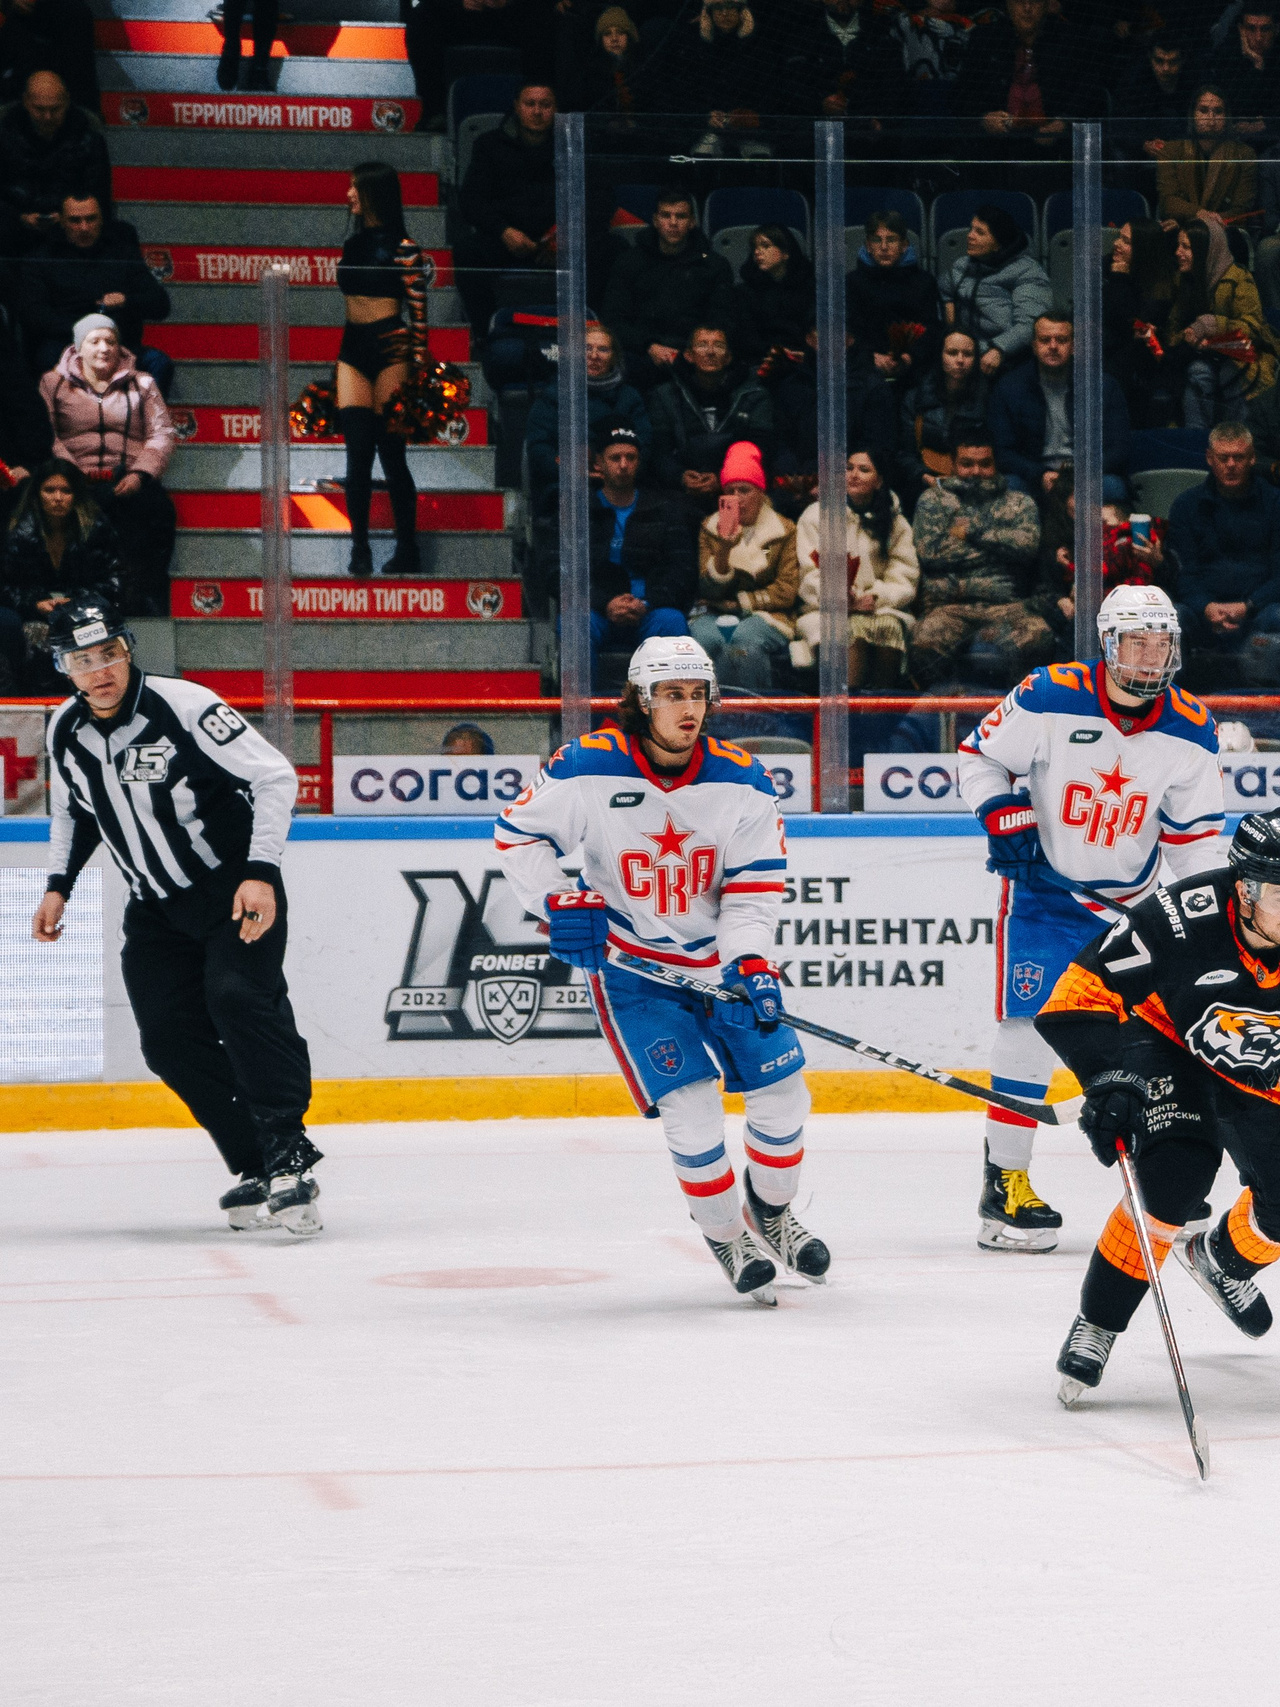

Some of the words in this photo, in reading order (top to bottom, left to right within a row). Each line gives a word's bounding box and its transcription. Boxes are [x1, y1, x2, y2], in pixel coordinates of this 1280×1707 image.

[172, 102, 282, 126] ТЕРРИТОРИЯ
[287, 105, 352, 128] ТИГРОВ
[373, 587, 445, 613] ТИГРОВ
[201, 704, 244, 743] 86
[999, 809, 1037, 831] WAR
[1060, 780, 1148, 850] СКА
[1240, 820, 1267, 843] OLIMPBET
[617, 844, 717, 918] СКА
[781, 877, 851, 904] БЕТ
[556, 889, 605, 906] CC
[1155, 887, 1187, 940] OLIMPBET
[774, 918, 994, 946] ТИНЕНТАЛ
[470, 954, 550, 971] FONBET
[779, 952, 944, 987] КЕЙНАЯ
[651, 967, 740, 1002] JETSPE
[752, 974, 777, 991] 22
[401, 992, 447, 1006] 2022
[555, 990, 588, 1004] 202
[760, 1046, 799, 1073] CCM
[1145, 1102, 1179, 1118] ЦЕНТР
[1146, 1111, 1202, 1126] АМУРСКИЙ
[1146, 1120, 1172, 1134] ТИГР
